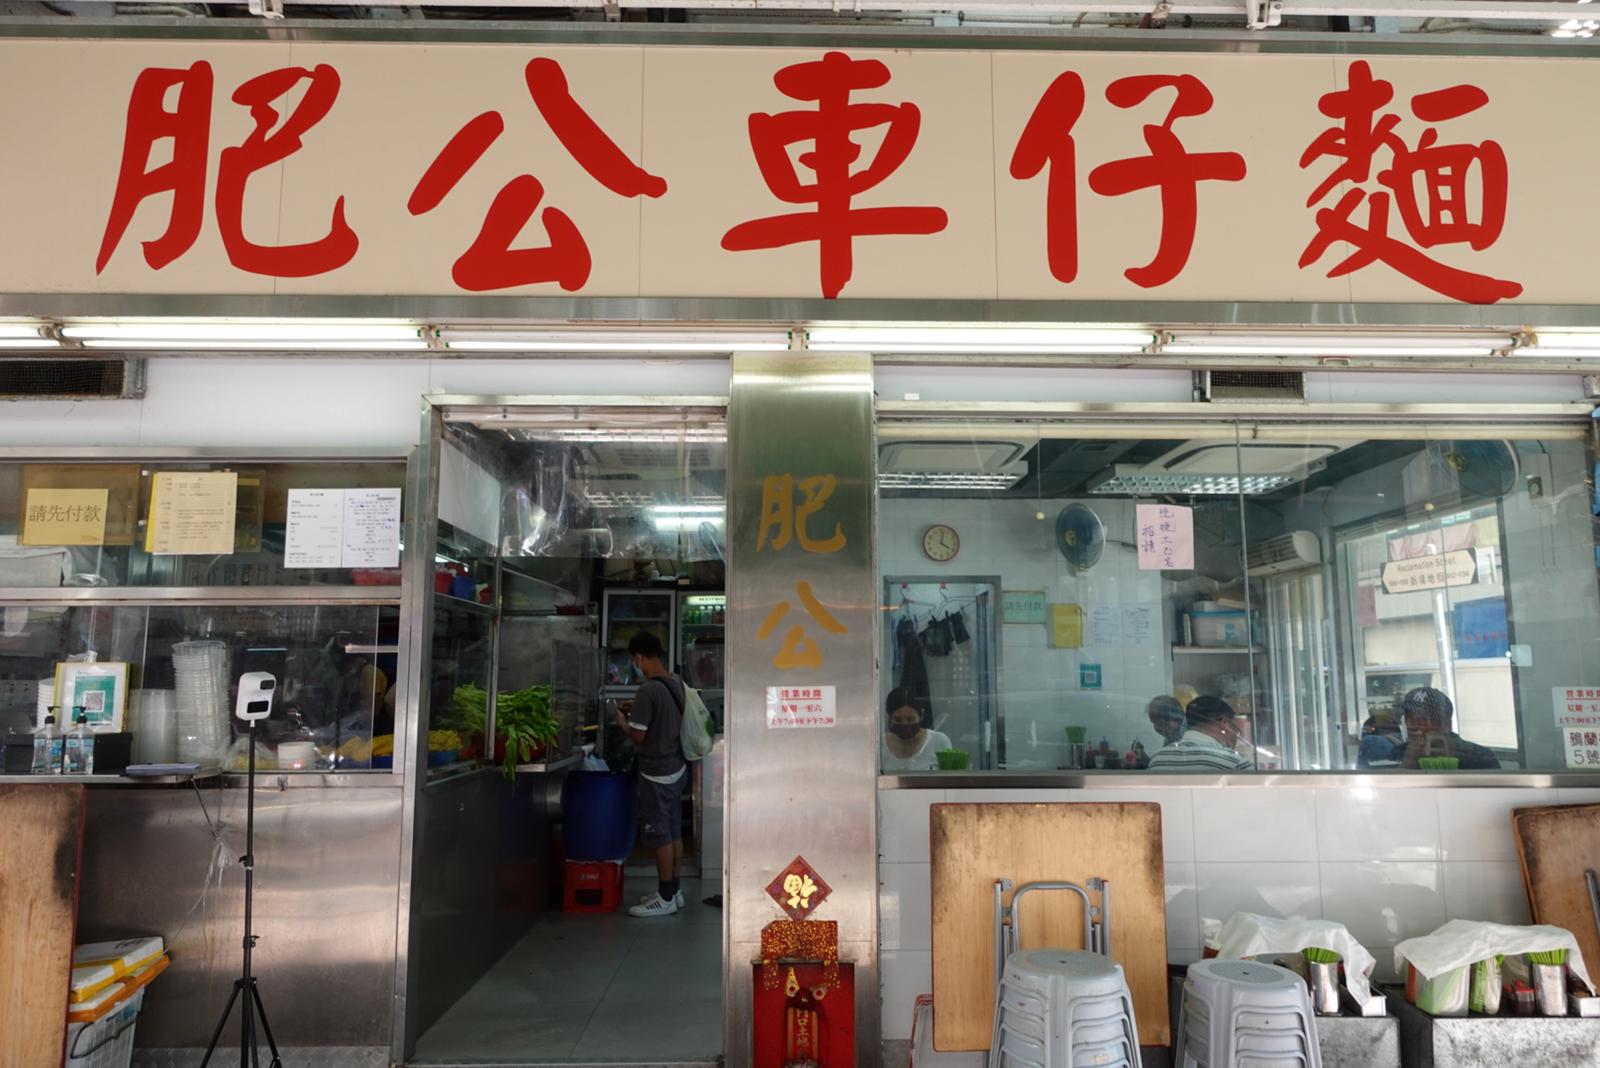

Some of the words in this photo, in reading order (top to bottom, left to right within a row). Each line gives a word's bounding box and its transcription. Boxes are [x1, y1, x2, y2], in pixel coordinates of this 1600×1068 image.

[96, 50, 1523, 305] 肥公車仔麵
[28, 503, 102, 523] 請先付款
[756, 473, 848, 670] 肥公
[1567, 703, 1600, 713] 星期一至
[1569, 731, 1600, 747] 鴉蘭
[1573, 749, 1600, 766] 5號
